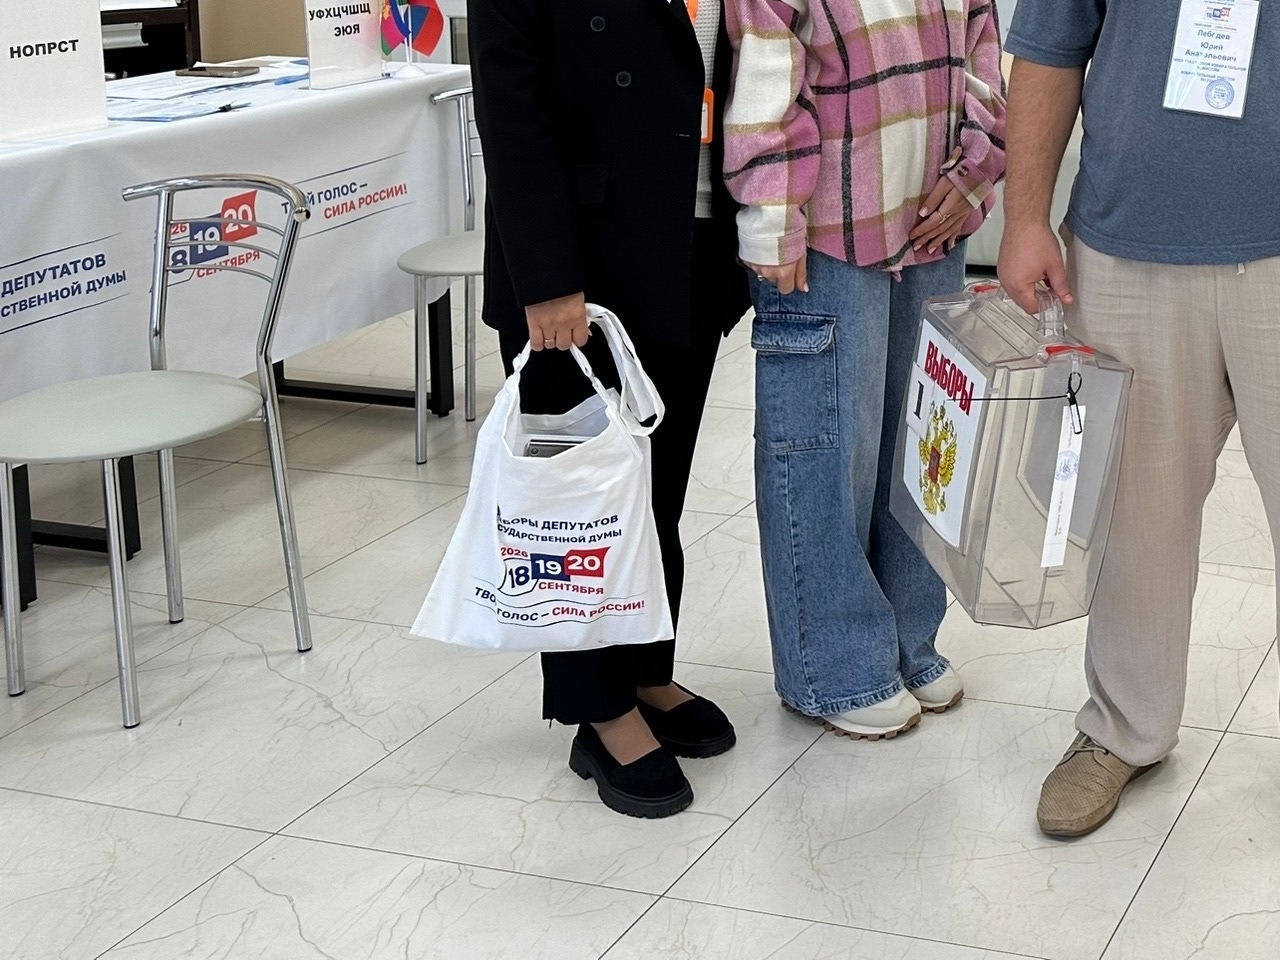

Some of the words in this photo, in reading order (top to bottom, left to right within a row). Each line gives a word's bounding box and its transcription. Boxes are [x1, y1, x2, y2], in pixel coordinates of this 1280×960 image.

[308, 2, 372, 21] УФХЦЧШЩ
[333, 23, 361, 37] ЭЮЯ
[9, 39, 79, 59] НОПРСТ
[281, 192, 315, 214] ТЙ
[317, 181, 358, 204] ГОЛОС
[323, 200, 357, 220] СИЛА
[358, 183, 408, 209] РОССИИ!
[170, 248, 188, 275] 8
[193, 225, 221, 255] 19
[224, 203, 253, 234] 20
[171, 222, 188, 235] 26
[196, 249, 261, 279] СЕНТЯБРЯ
[1, 253, 107, 298] ДЕПУТАТОВ
[0, 281, 82, 318] СТВЕННОЙ
[85, 269, 127, 296] ДУМЫ
[924, 340, 975, 417] ВЫБОРЫ
[497, 523, 586, 543] СУДАРСТВЕННОЙ
[588, 528, 622, 544] ДУМЫ
[499, 514, 539, 528] БОРЫ
[541, 514, 619, 532] ДЕПУТАТОВ
[500, 547, 529, 558] 2026
[508, 565, 530, 589] 18
[535, 559, 562, 576] 19
[567, 555, 601, 572] 20
[474, 586, 497, 606] ТВО
[538, 581, 605, 596] СЕНТЯБРЯ
[497, 607, 539, 622] ГОЛОС
[552, 606, 587, 618] СИЛА
[589, 600, 645, 618] РОССИИ!
